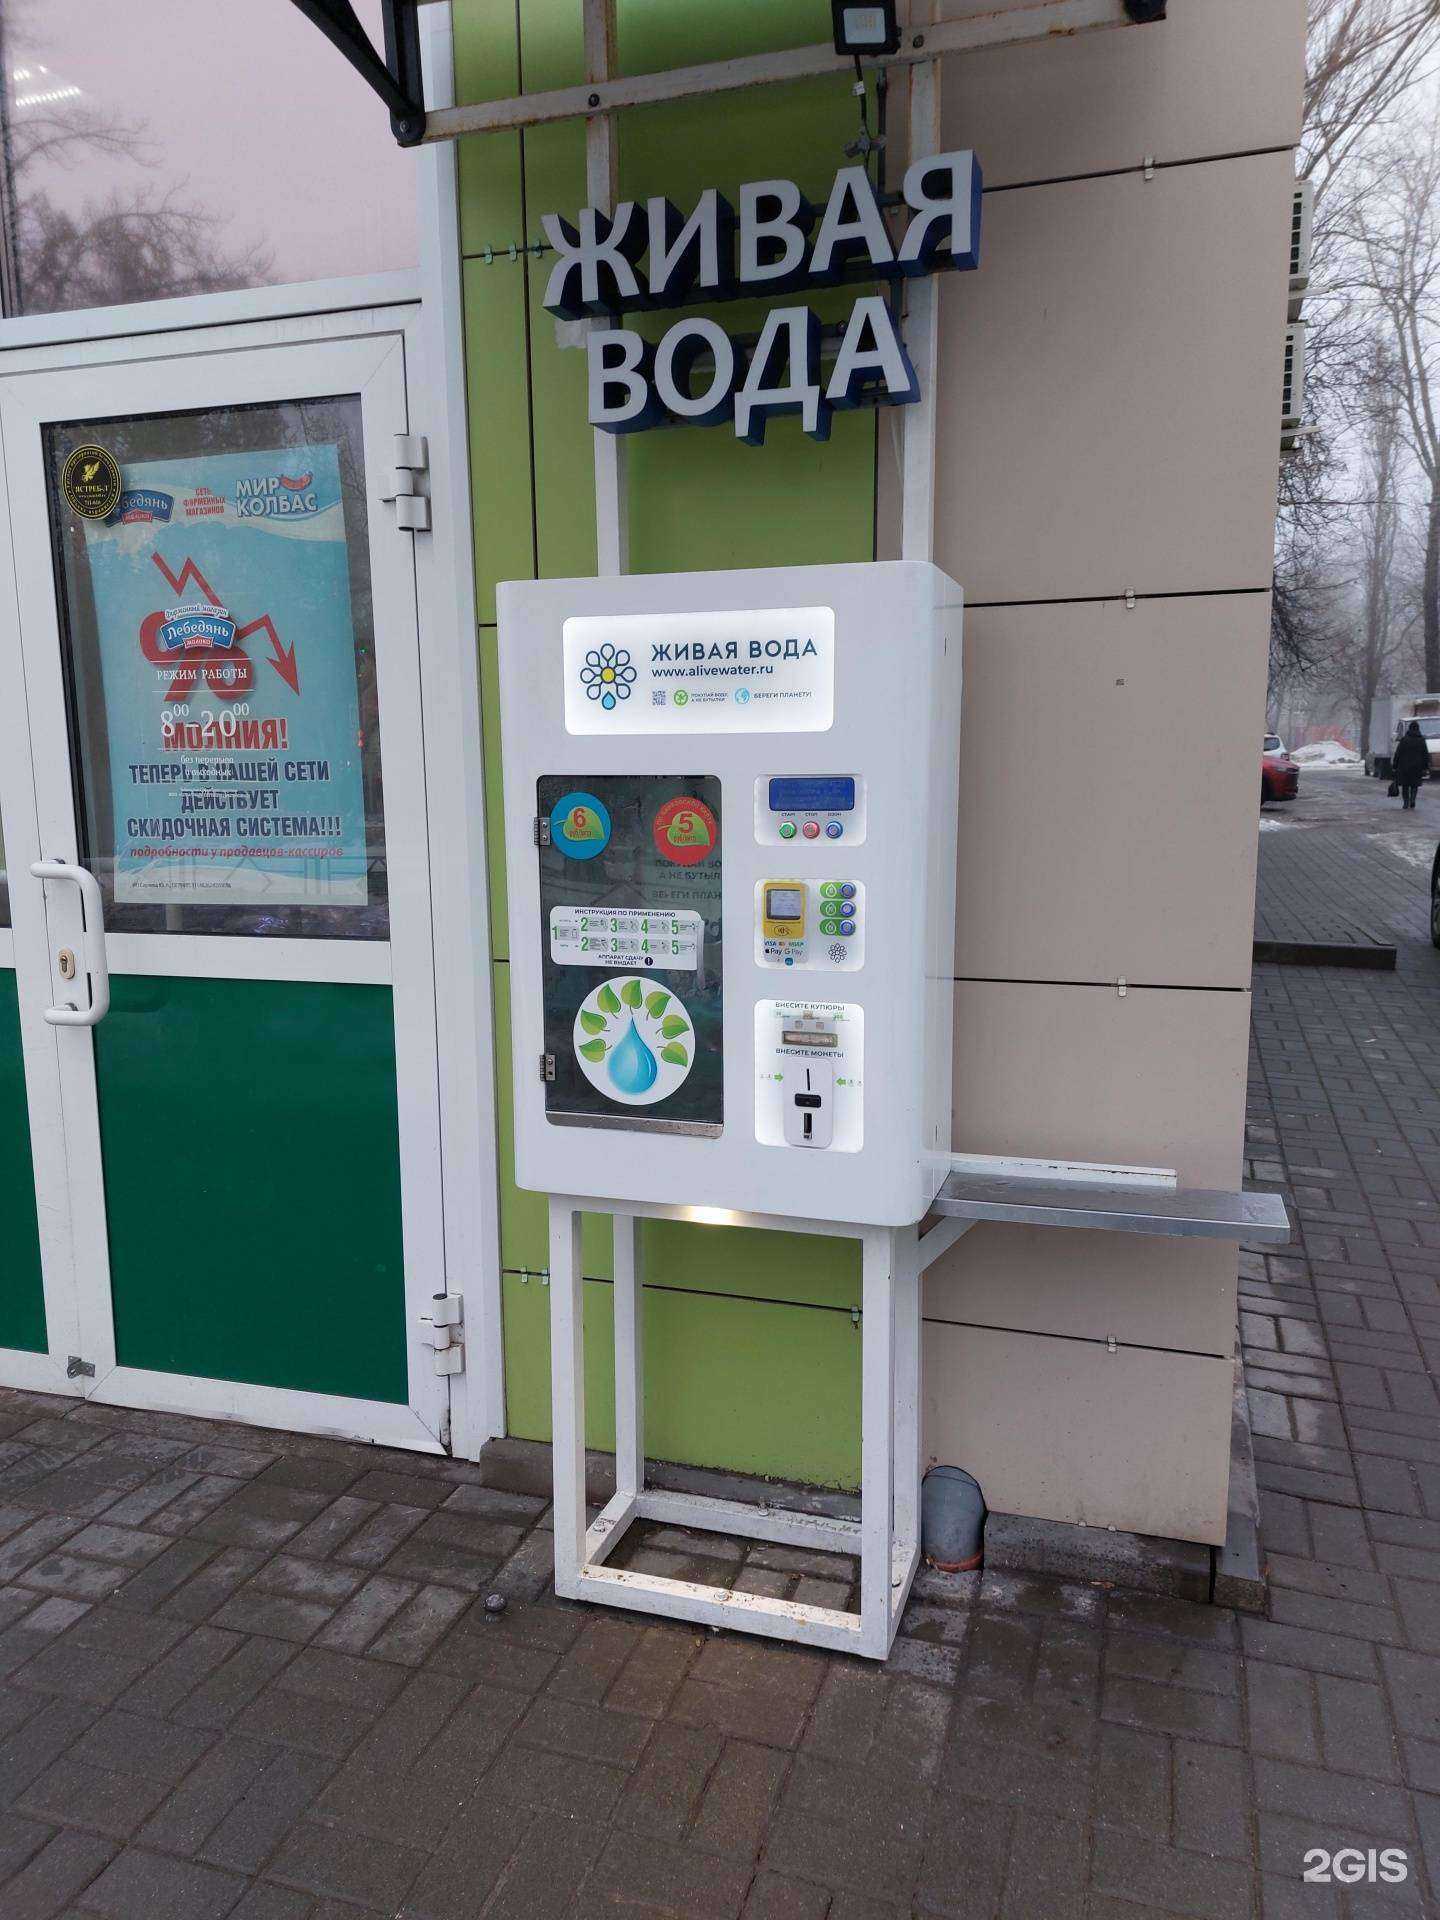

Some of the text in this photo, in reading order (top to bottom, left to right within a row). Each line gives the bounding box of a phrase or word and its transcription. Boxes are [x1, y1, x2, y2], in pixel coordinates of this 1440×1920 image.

[541, 149, 977, 308] ЖИВАЯ
[587, 296, 914, 441] ВОДА
[236, 477, 280, 497] МИР
[236, 492, 318, 517] КОЛБАС
[168, 620, 229, 640] Лебедянь
[651, 638, 818, 661] ЖИВАЯ ВОДА
[156, 668, 248, 680] РЕЖИМ РАБОТЫ
[651, 665, 773, 677] www.alivewater.ru
[163, 717, 288, 750] МОЛНИЯ!
[129, 763, 193, 784] ТЕПЕРЬ
[215, 757, 279, 782] НАШЕЙ
[284, 760, 330, 781] СЕТИ
[181, 786, 279, 813] ДЕЙСТВУЕТ
[573, 807, 585, 829] 6
[679, 813, 693, 834] 5
[127, 816, 341, 841] СКИДОЧНАЯ СИСТЕМА!!!
[130, 845, 344, 859] подробности у продавцов-кассиров
[580, 917, 589, 931] 2
[610, 918, 618, 932] 3
[641, 919, 649, 933] 4
[671, 920, 679, 934] 5
[552, 926, 558, 940] 1
[581, 937, 589, 951] 2
[610, 938, 618, 952] 3
[641, 939, 649, 953] 4
[671, 940, 679, 954] 5
[810, 1003, 845, 1011] КУПЮРЫ
[775, 1048, 844, 1058] ВНЕСИТЕ МОНЕТЫ
